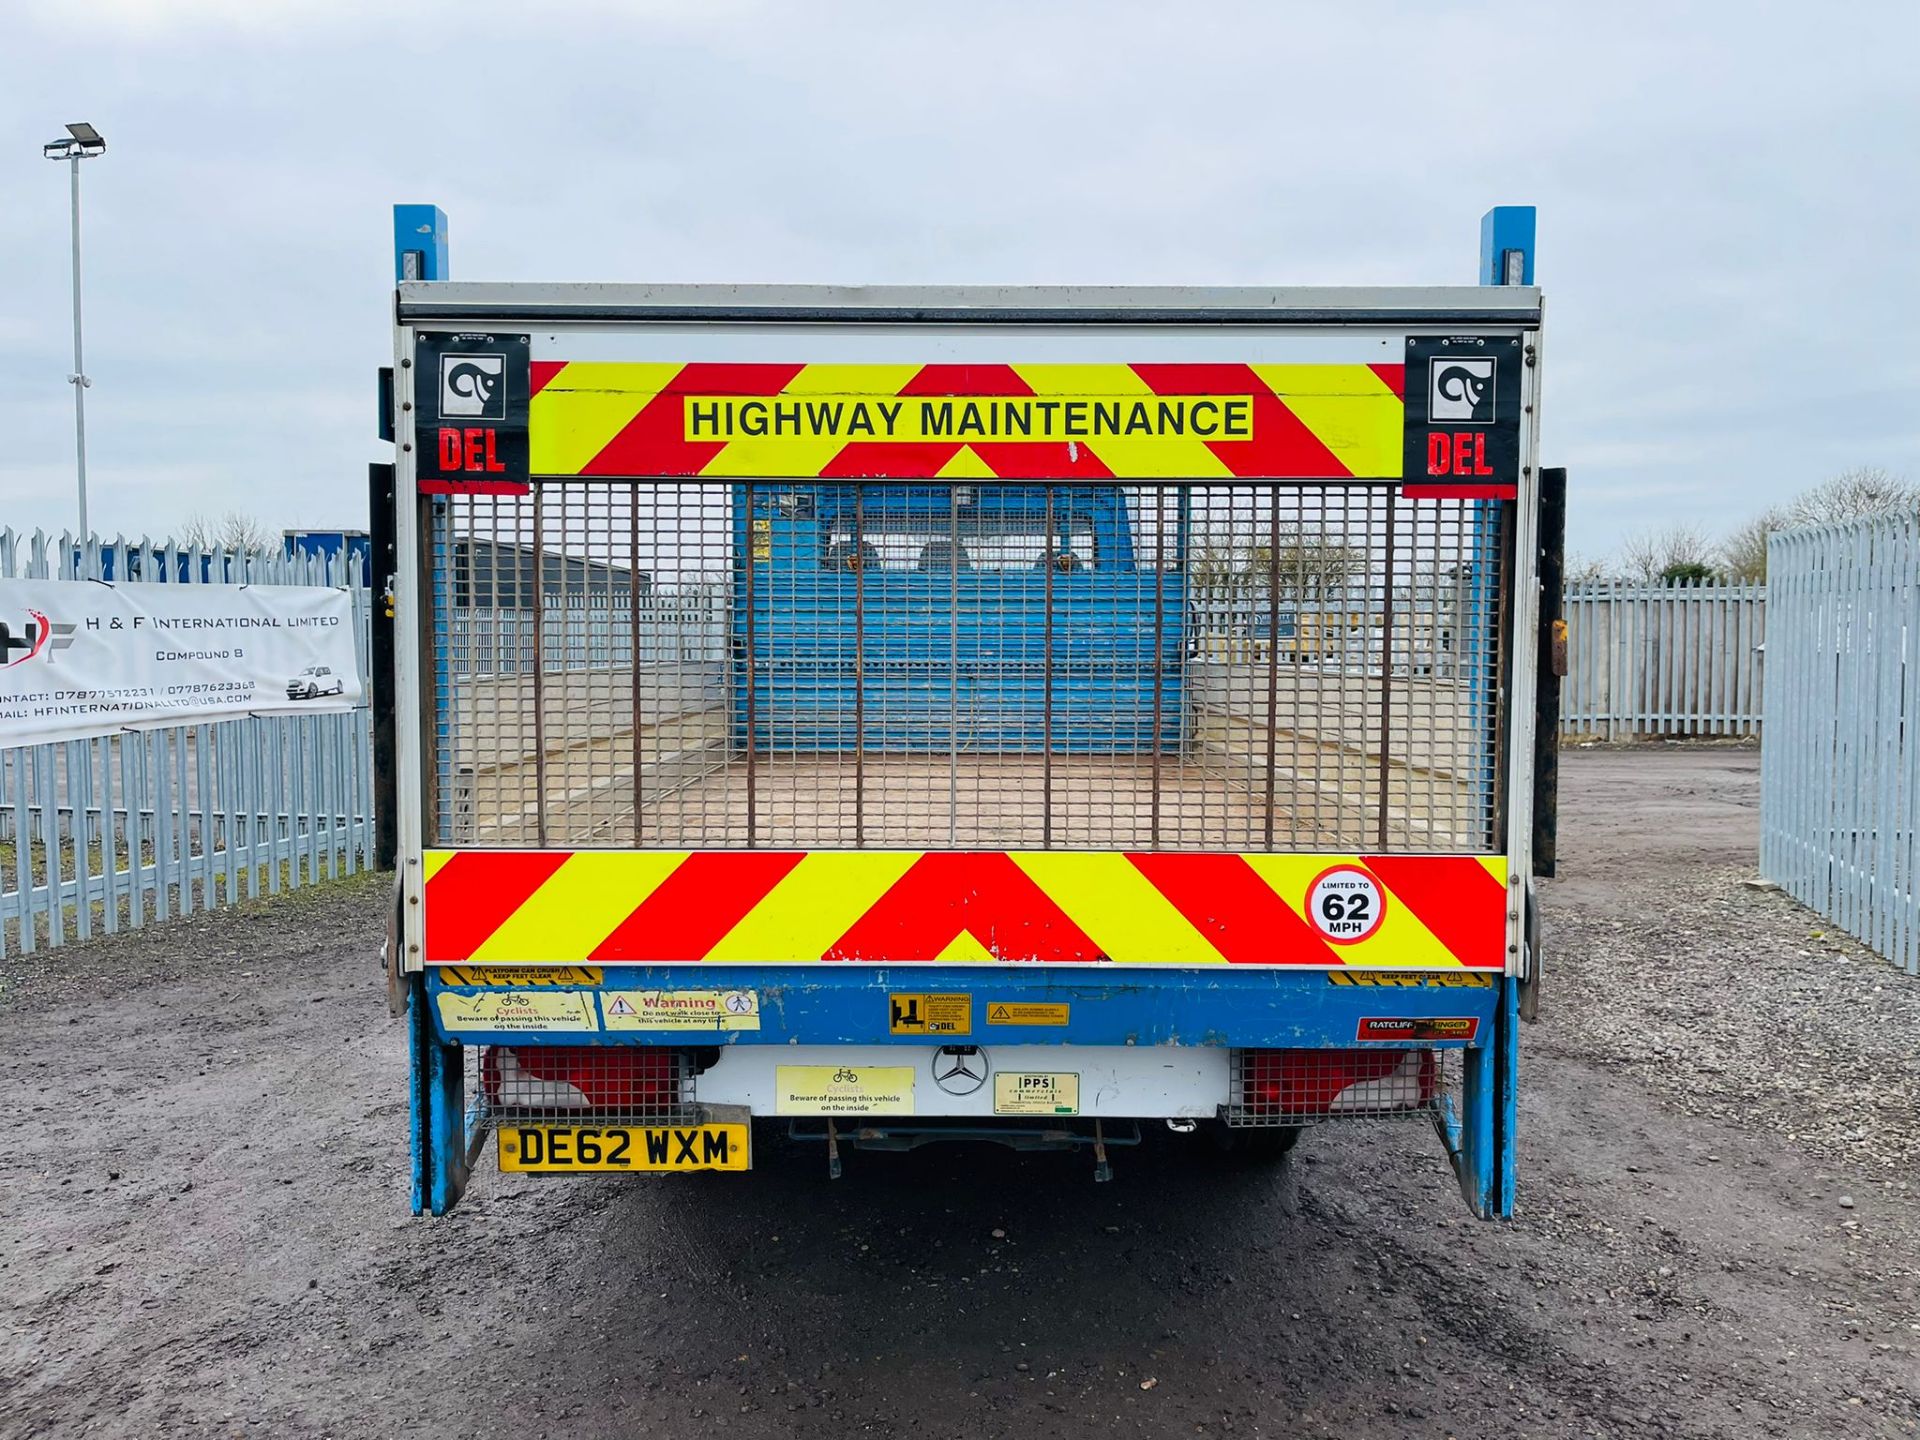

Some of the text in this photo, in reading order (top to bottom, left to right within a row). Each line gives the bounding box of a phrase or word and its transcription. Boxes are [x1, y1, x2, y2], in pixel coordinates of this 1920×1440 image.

[692, 401, 1249, 436] HIGHWAY MAINTENANCE
[438, 427, 506, 473] DEL
[1427, 432, 1494, 476] DEL
[86, 616, 100, 630] H
[109, 616, 123, 630] &
[133, 616, 146, 629] F
[287, 615, 339, 628] LIMITED
[155, 649, 230, 661] COMPOUND
[0, 692, 49, 704] NTACT:
[1322, 893, 1370, 921] 62
[1329, 922, 1363, 933] MPH
[643, 997, 716, 1010] Warning
[496, 1007, 539, 1015] Cyclists
[500, 1015, 533, 1023] passing
[940, 1022, 955, 1030] DEL
[826, 1084, 865, 1094] Cyclists
[1023, 1078, 1050, 1089] PPS
[828, 1095, 857, 1103] passing
[518, 1129, 729, 1165] DE62 WXM
